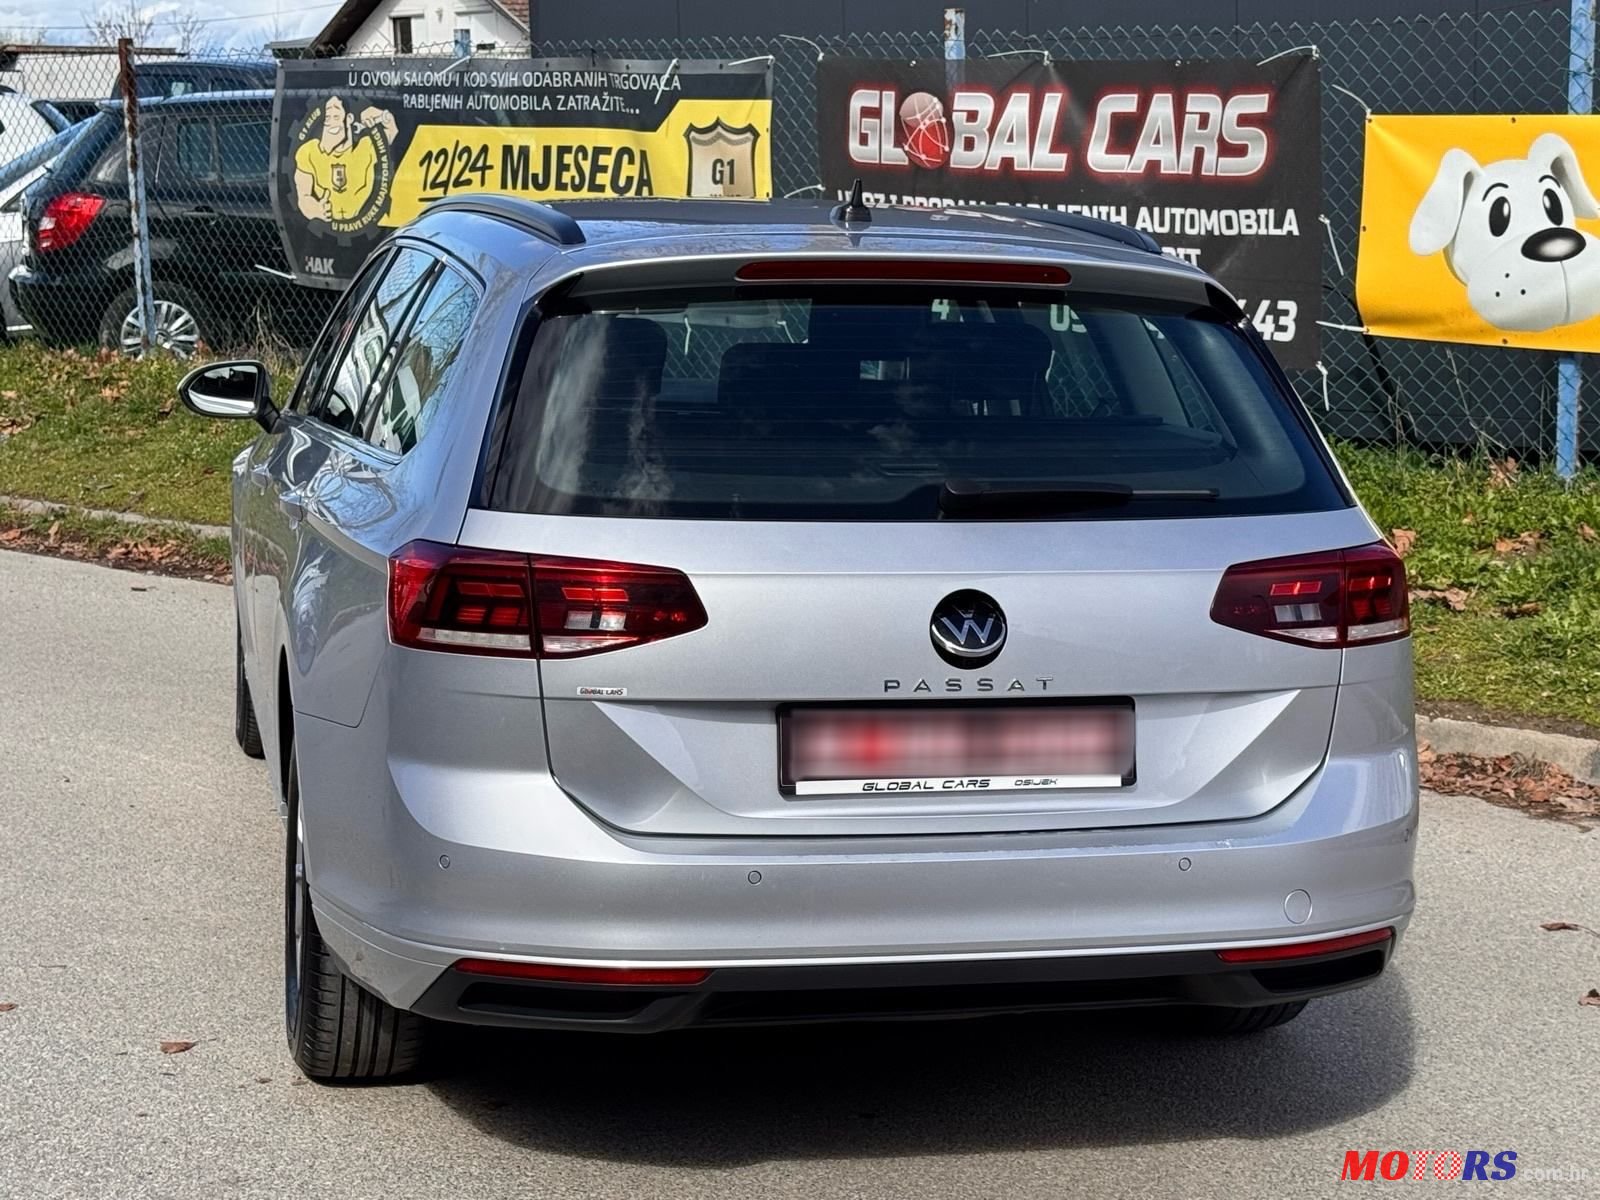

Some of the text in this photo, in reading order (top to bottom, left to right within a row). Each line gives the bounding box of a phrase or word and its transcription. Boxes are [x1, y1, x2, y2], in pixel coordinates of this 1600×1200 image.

[348, 72, 358, 86] U
[361, 72, 401, 86] OVOM
[403, 72, 451, 86] SALONU
[463, 73, 488, 87] KOD
[490, 73, 518, 87] SVIH
[522, 72, 607, 88] ODABRANIH
[402, 91, 640, 114] RABLJENIH AUTOMOBILA ZATRAŽITE...
[1087, 92, 1270, 176] CARS
[418, 140, 654, 197] 12/24 MJESECA
[711, 158, 735, 186] G1
[339, 222, 363, 232] PRAVE
[1135, 206, 1300, 236] AUTOMOBILA
[304, 256, 335, 275] HAK
[884, 677, 1053, 693] PASSAT
[862, 779, 1059, 792] GLOBAL CARS OSIJEK
